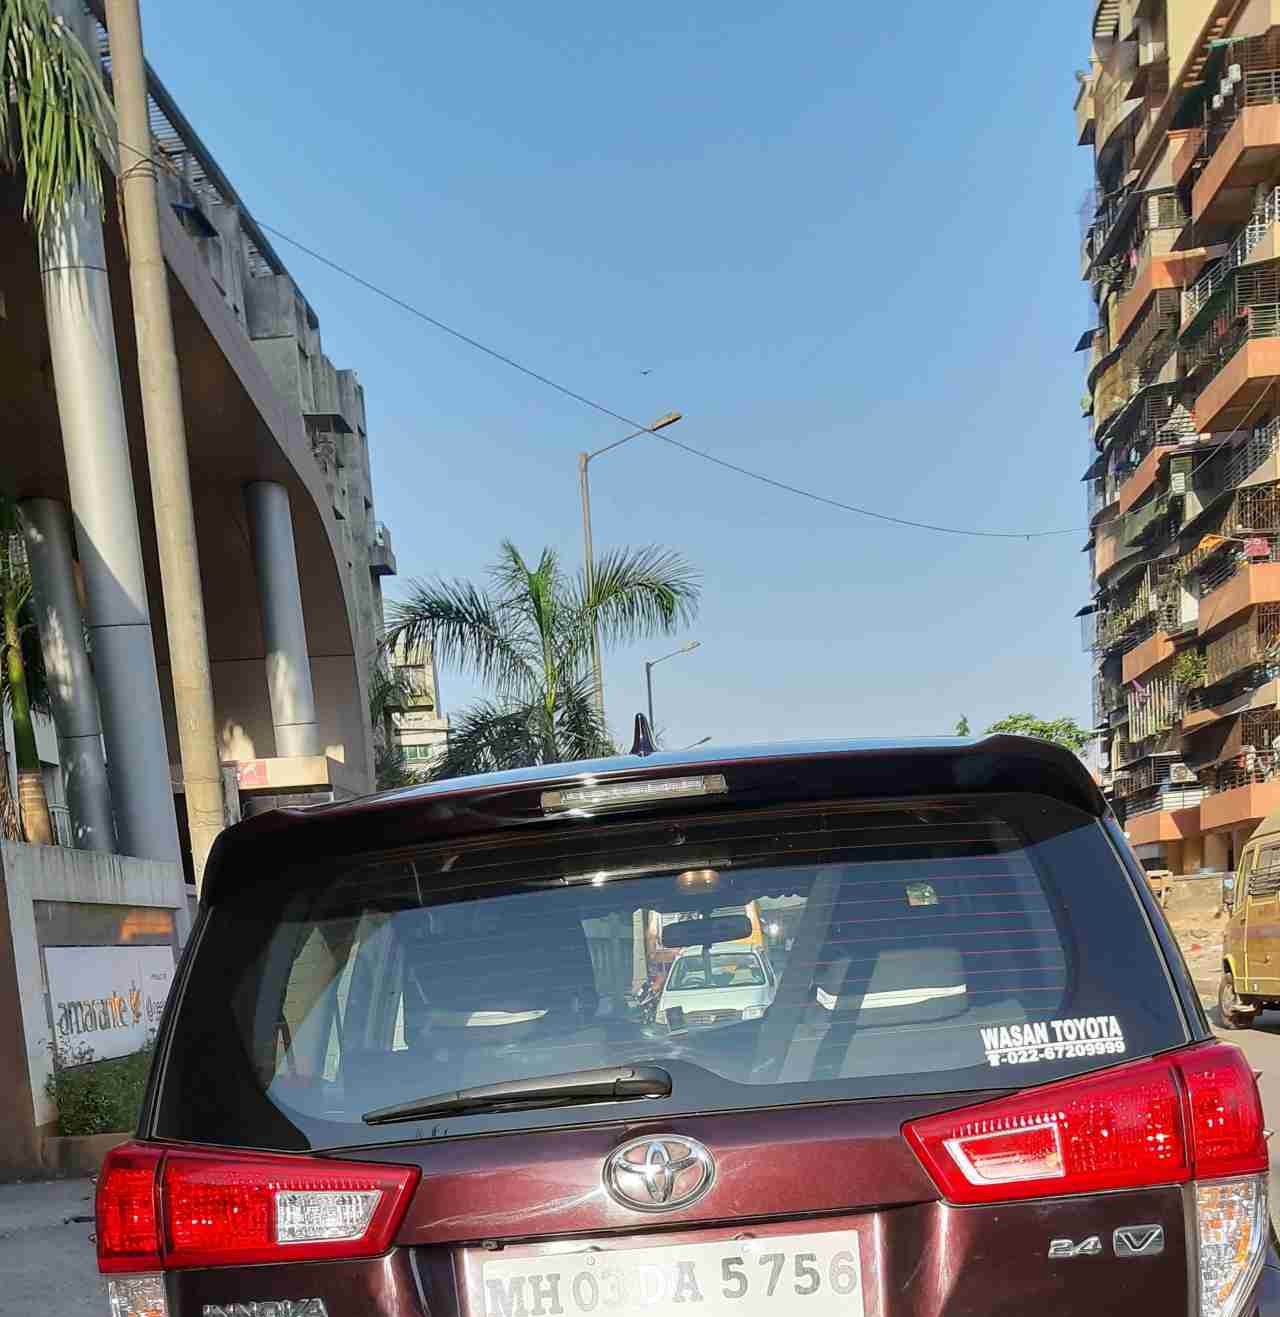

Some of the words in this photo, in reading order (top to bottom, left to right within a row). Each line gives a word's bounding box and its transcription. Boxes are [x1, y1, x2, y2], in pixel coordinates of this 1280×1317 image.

[57, 992, 128, 1036] amarante
[980, 1022, 1048, 1049] WASAN
[1051, 1016, 1122, 1042] TOYOTA
[637, 1261, 704, 1307] DA
[721, 1250, 857, 1298] 5756
